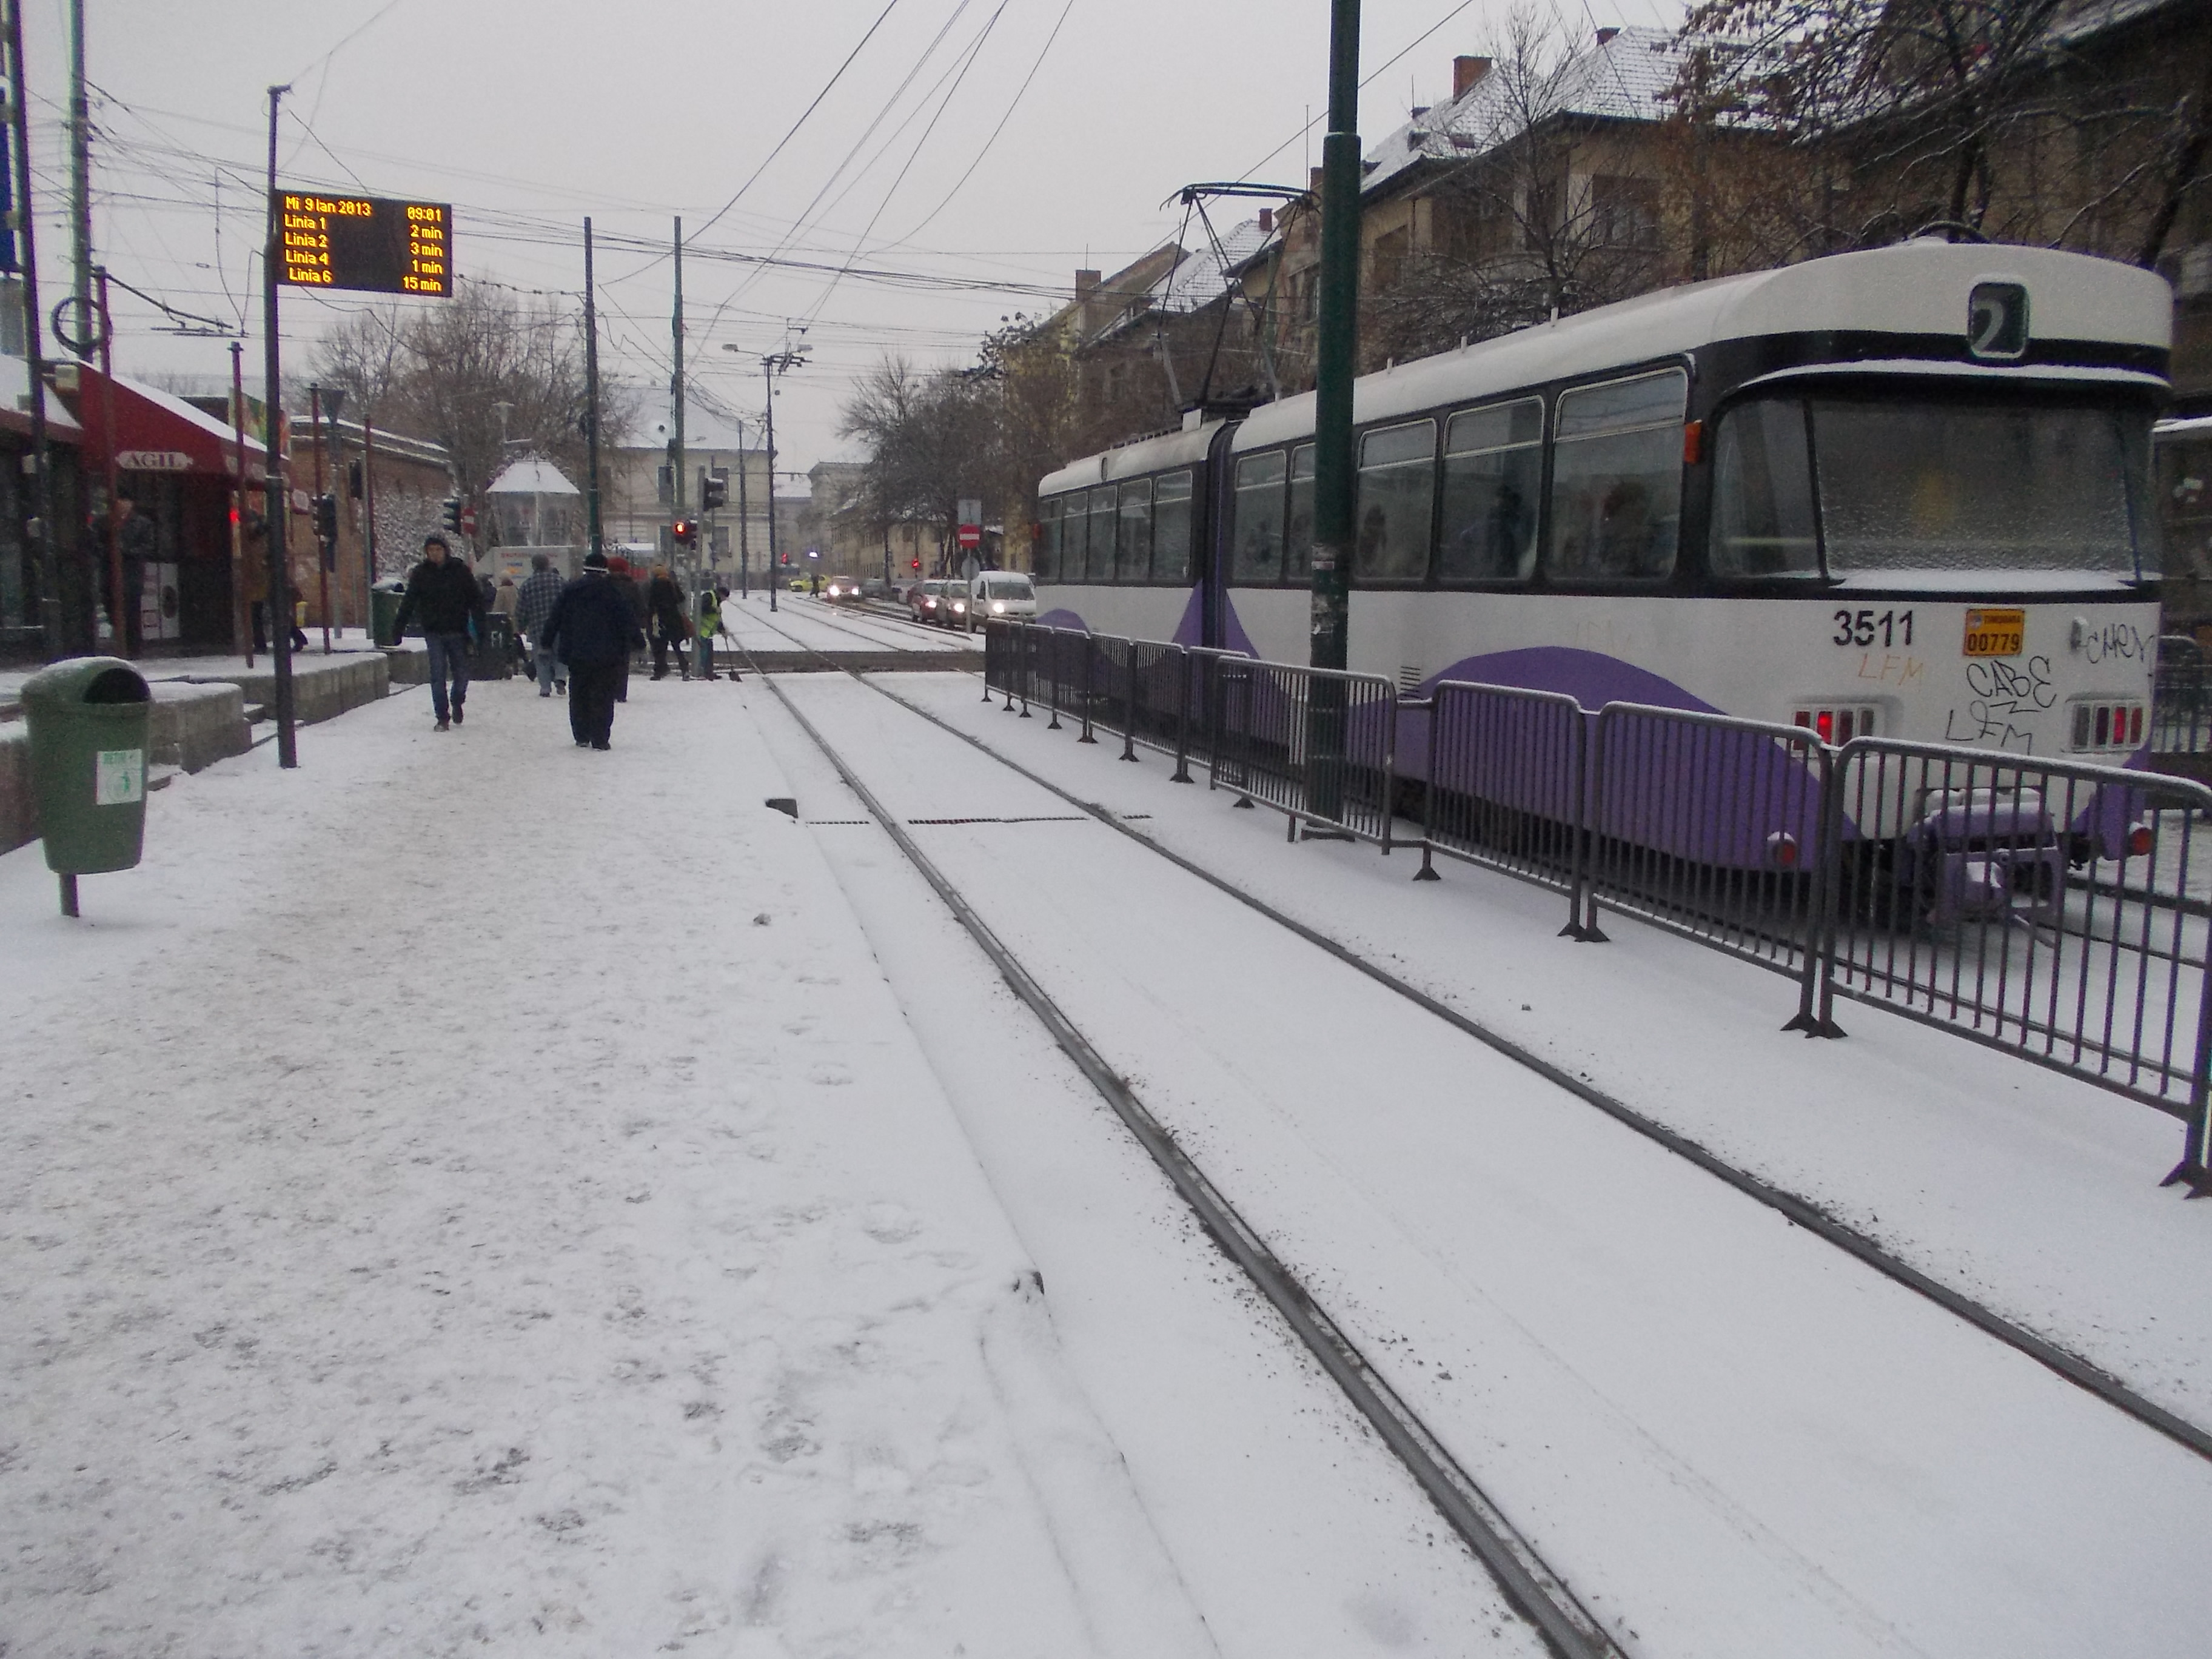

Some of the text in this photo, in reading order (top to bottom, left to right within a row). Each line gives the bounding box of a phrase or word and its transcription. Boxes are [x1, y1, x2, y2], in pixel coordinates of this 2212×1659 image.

[285, 195, 300, 210] Mi
[305, 198, 313, 212] 9
[338, 200, 372, 216] 2013
[407, 207, 441, 221] 09:01
[284, 214, 443, 240] Linia 1 2 min
[285, 232, 443, 258] Linia 2 3 min
[285, 249, 443, 274] Linia 4 1 min
[289, 267, 442, 292] Linia 6 15 min
[1972, 301, 2003, 352] 2
[1834, 610, 1913, 647] 3511
[1968, 633, 2020, 651] 00779
[1966, 655, 2057, 708] CABE
